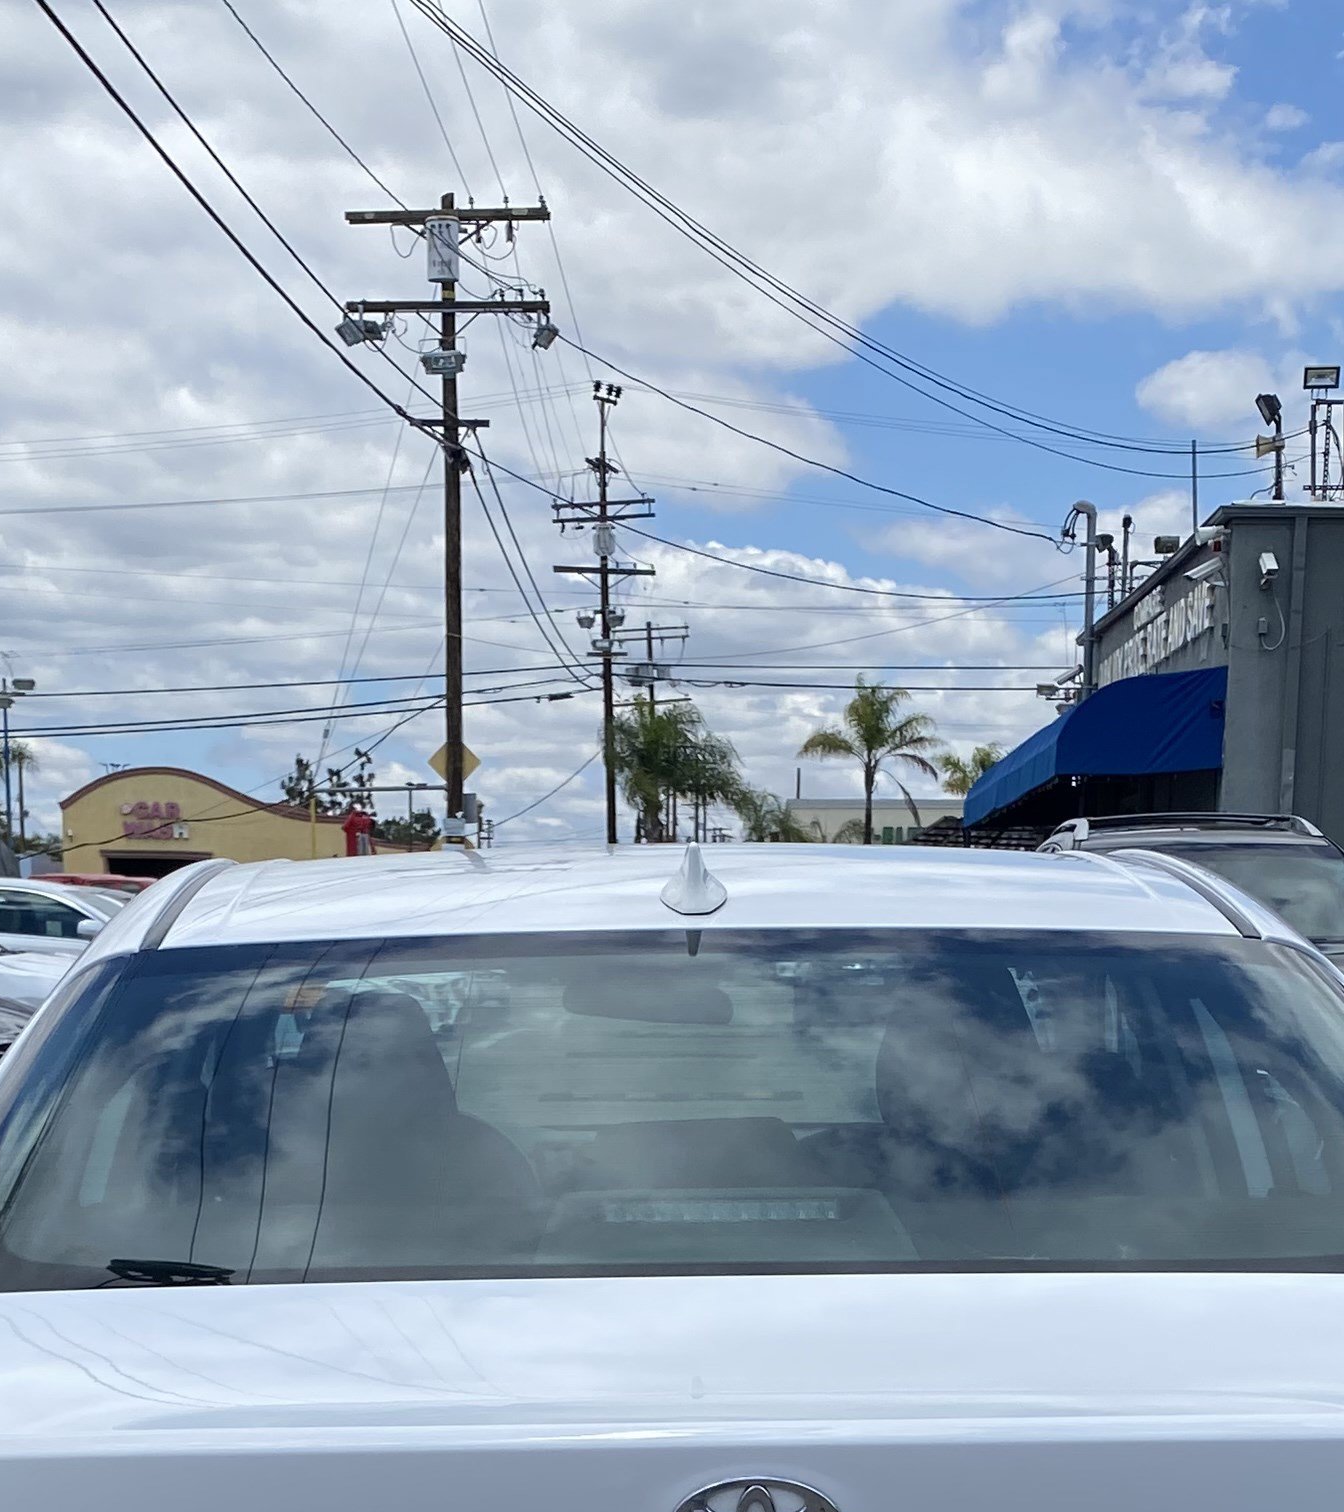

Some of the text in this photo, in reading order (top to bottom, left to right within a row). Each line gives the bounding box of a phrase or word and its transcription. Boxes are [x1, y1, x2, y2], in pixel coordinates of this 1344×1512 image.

[1167, 597, 1186, 654] AND
[1186, 580, 1213, 642] SAVE
[135, 801, 180, 819] CAR
[123, 821, 189, 839] WASH
